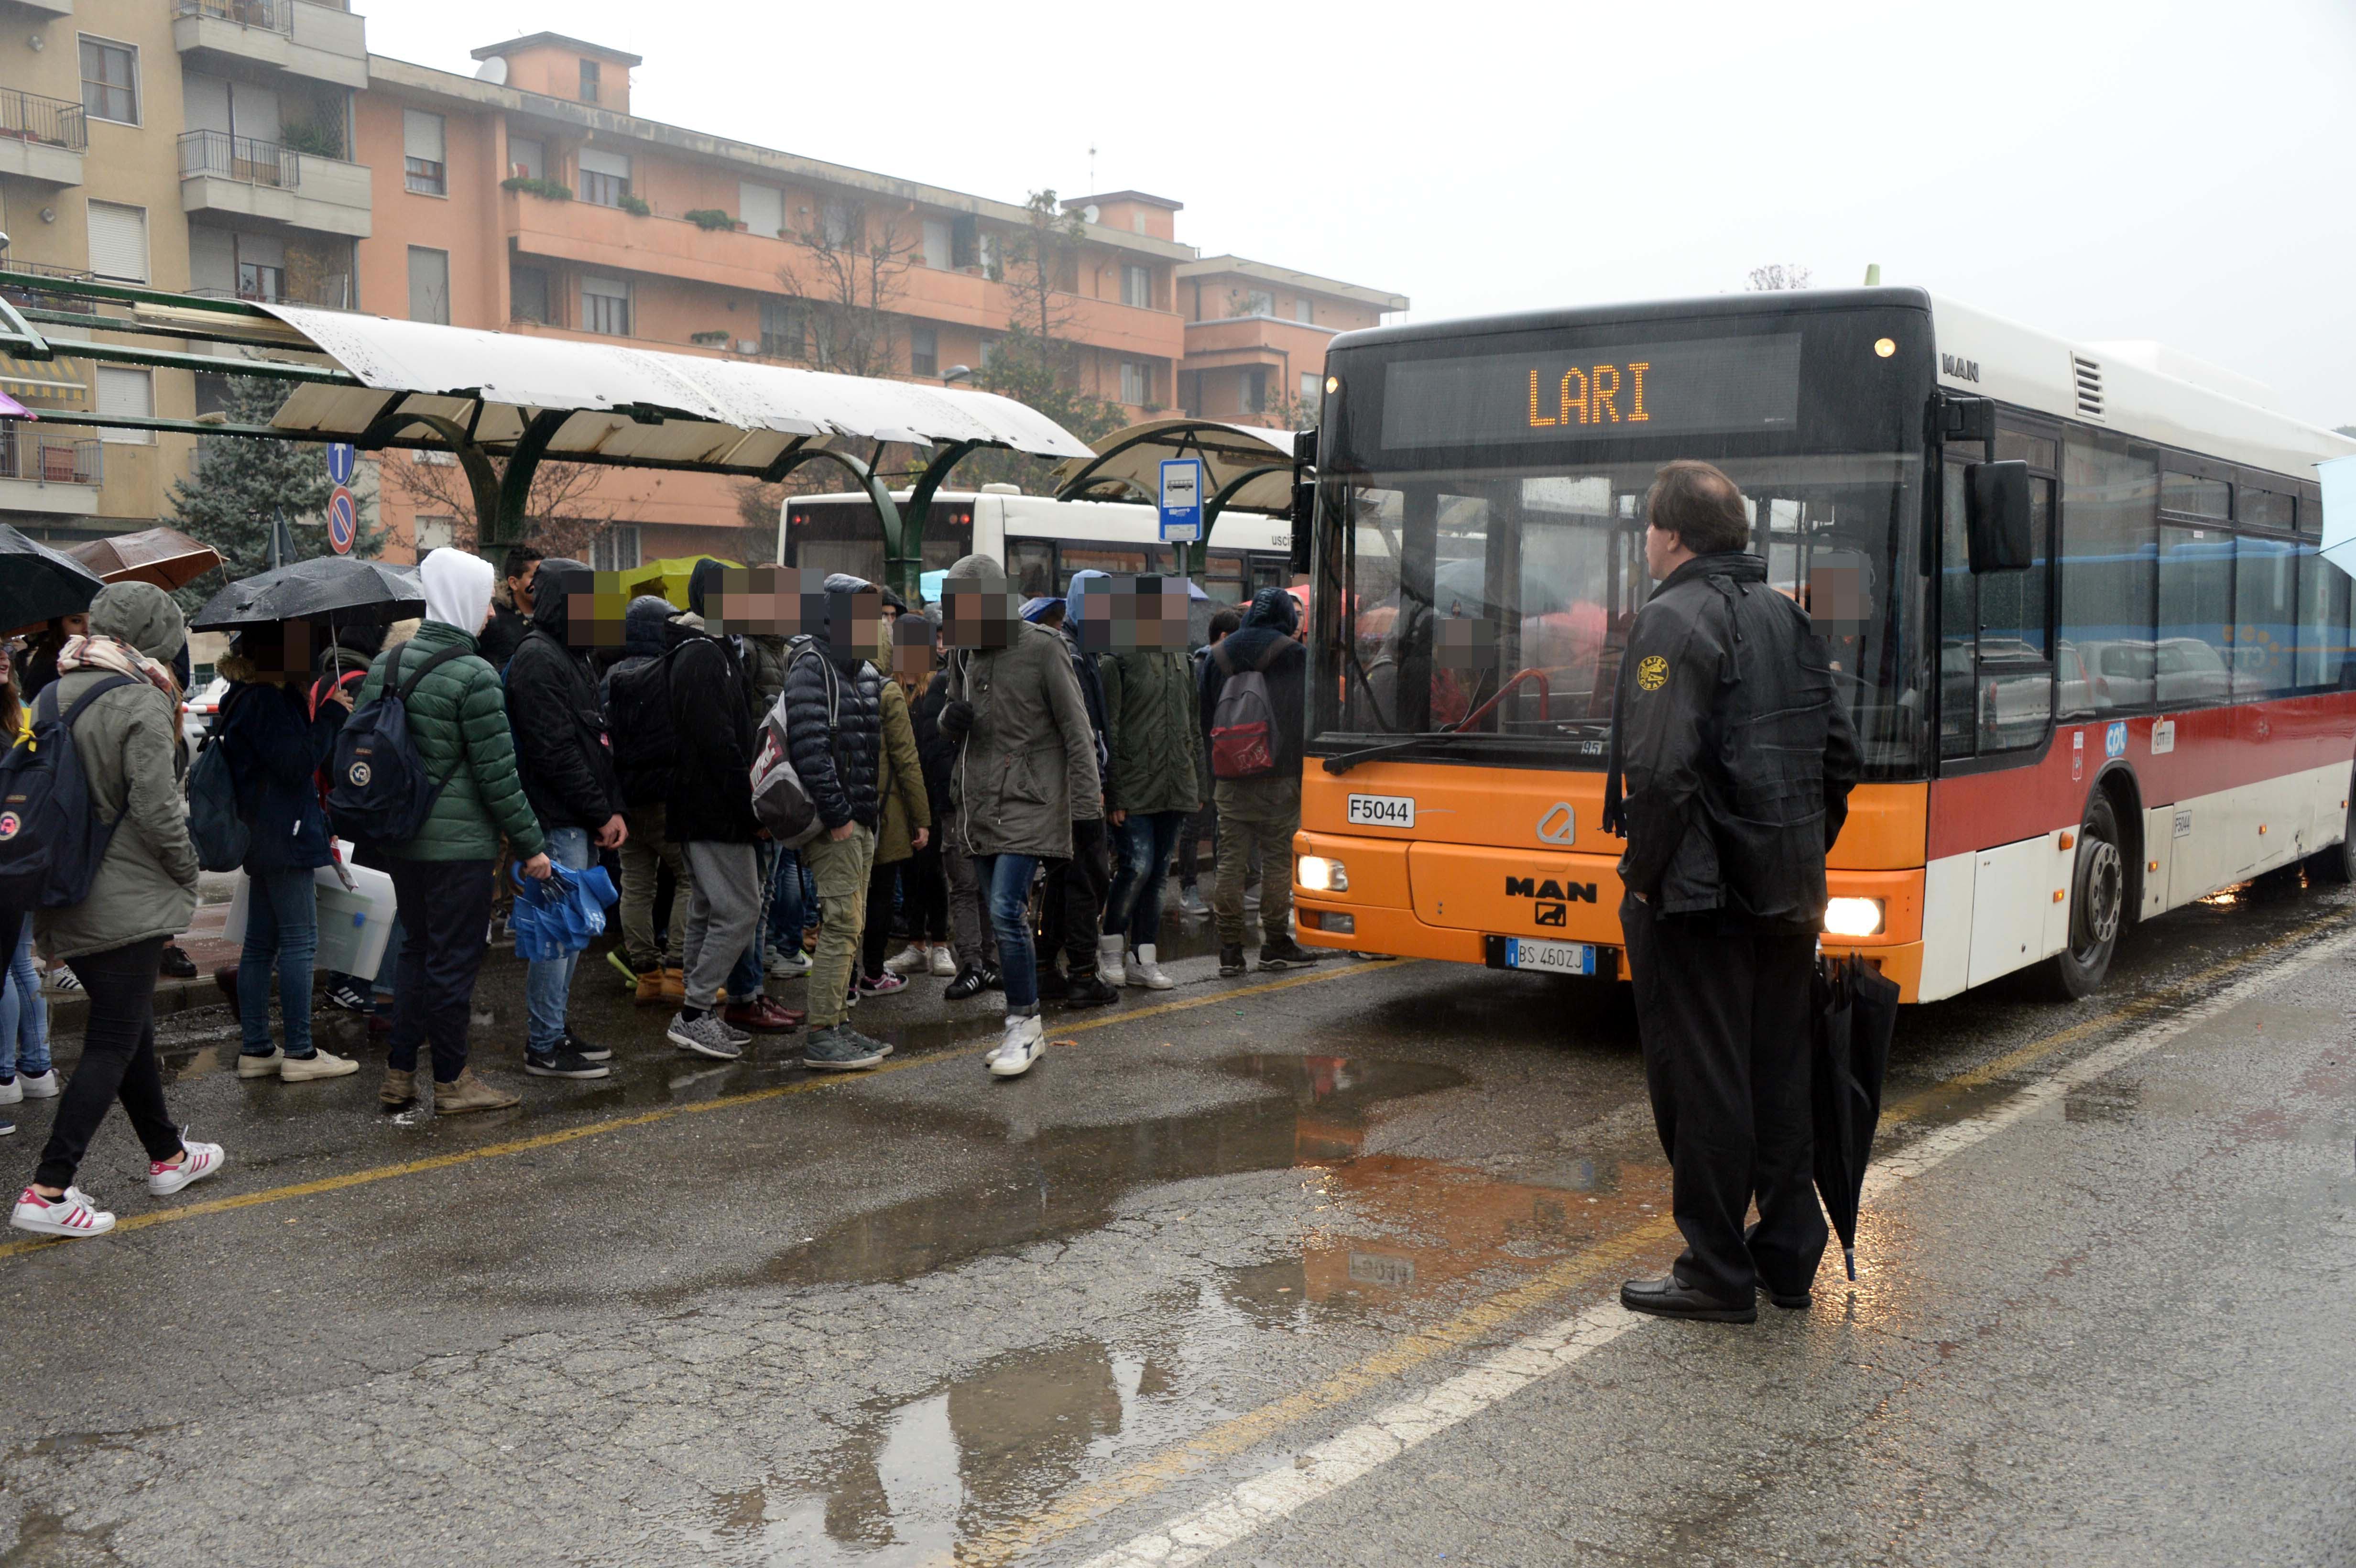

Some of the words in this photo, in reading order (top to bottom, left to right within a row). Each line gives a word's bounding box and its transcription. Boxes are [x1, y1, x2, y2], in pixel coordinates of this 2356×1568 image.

[1942, 353, 1979, 382] MAN
[1530, 362, 1649, 426] LARI
[1640, 657, 1666, 669] FAISA
[1640, 679, 1664, 689] CISAL
[1583, 741, 1599, 754] 95
[2106, 722, 2125, 757] cpt
[1351, 799, 1408, 821] F5044
[2175, 816, 2190, 832] F5044
[1506, 876, 1597, 904] MAN
[1519, 945, 1535, 963] BS
[1540, 947, 1582, 968] 460ZJ
